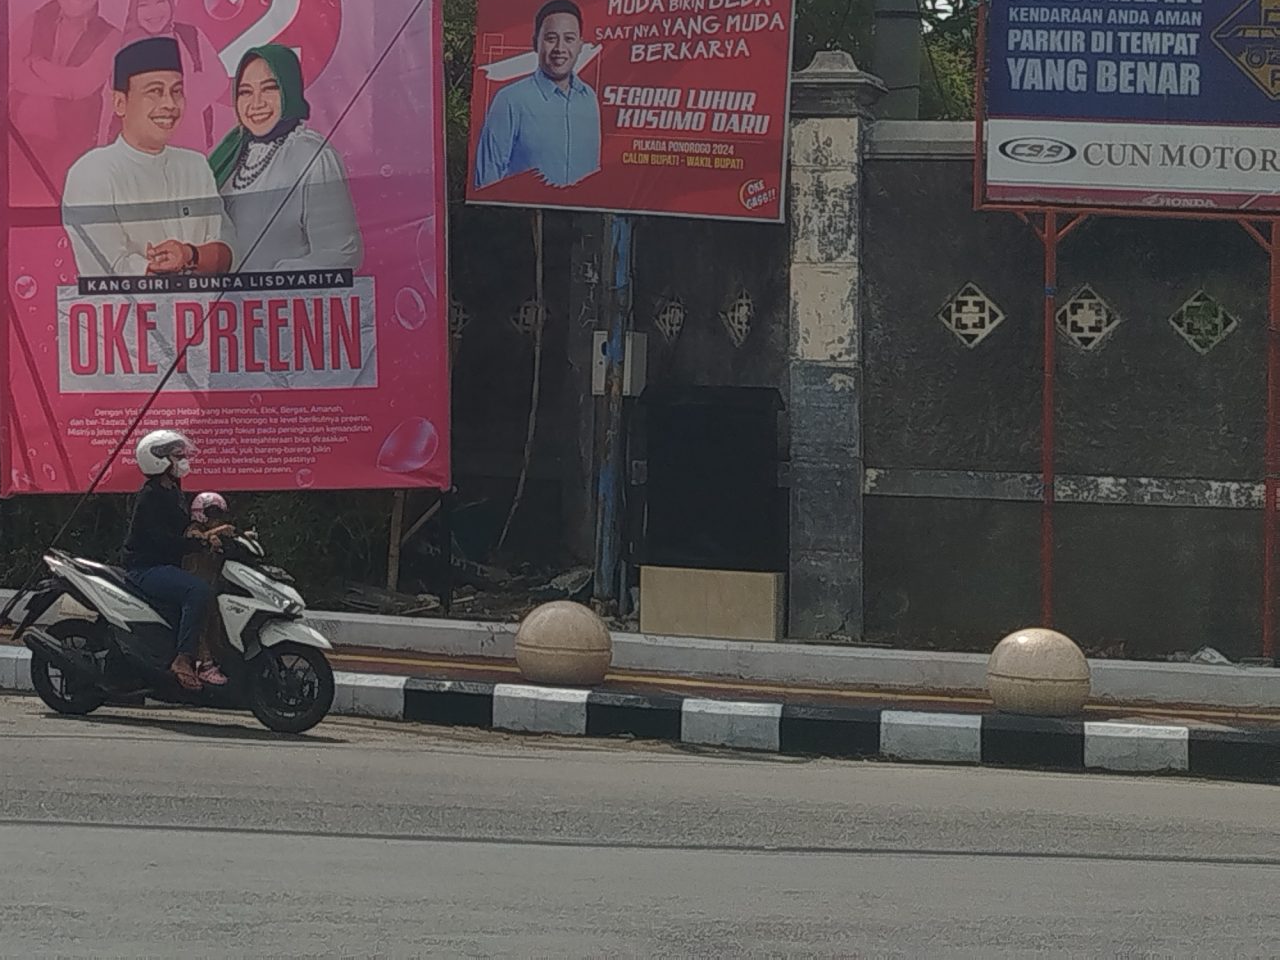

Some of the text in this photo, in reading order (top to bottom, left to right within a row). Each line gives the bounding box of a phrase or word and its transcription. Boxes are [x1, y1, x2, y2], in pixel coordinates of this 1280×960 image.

[662, 15, 721, 39] YANG
[725, 12, 785, 33] MUDA
[1008, 6, 1202, 27] KENDARAAN ANDA AMAN
[630, 38, 751, 63] BERKARYA
[1007, 29, 1200, 56] PARKIR DI TEMPAT
[1006, 57, 1201, 96] YANG BENAR
[602, 85, 757, 112] SEGORO LUHUR
[616, 108, 770, 135] KUSUMO DARU
[632, 139, 735, 155] PILKADA PONOROGO 2024
[1083, 142, 1153, 167] CUN
[1159, 143, 1280, 172] MOTOR
[622, 152, 744, 170] CALON BUPATI WAKIL BUPATI
[87, 278, 131, 291] KANG
[137, 278, 170, 290] GIRI
[250, 272, 345, 288] LISDYARITA
[69, 296, 363, 376] OKE PREENN
[201, 407, 220, 416] yang
[230, 416, 268, 425] Ponorogo
[239, 446, 253, 455] yuk
